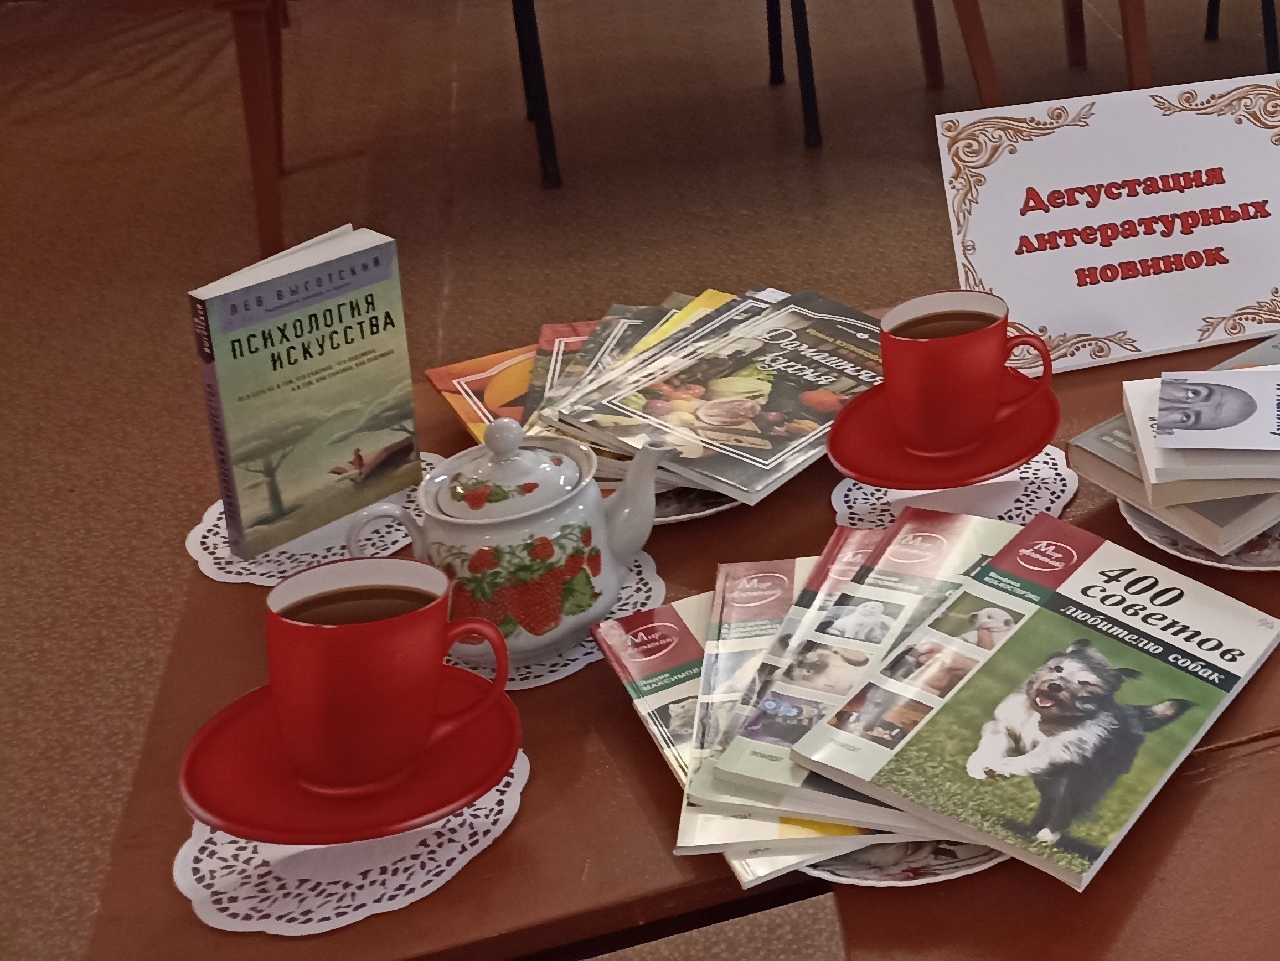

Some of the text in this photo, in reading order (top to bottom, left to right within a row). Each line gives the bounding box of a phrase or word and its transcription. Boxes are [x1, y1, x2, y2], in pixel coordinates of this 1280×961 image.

[1019, 166, 1226, 216] Дегустация
[1014, 199, 1272, 256] литературных
[1074, 246, 1230, 288] новинок
[229, 292, 377, 360] ПСИХОЛОГИЯ
[270, 310, 396, 372] ИСКУССТВА
[1098, 567, 1185, 607] 400
[1060, 605, 1226, 685] любителю собак
[1080, 584, 1246, 664] советов
[642, 667, 701, 692] МАКСИМОВ
